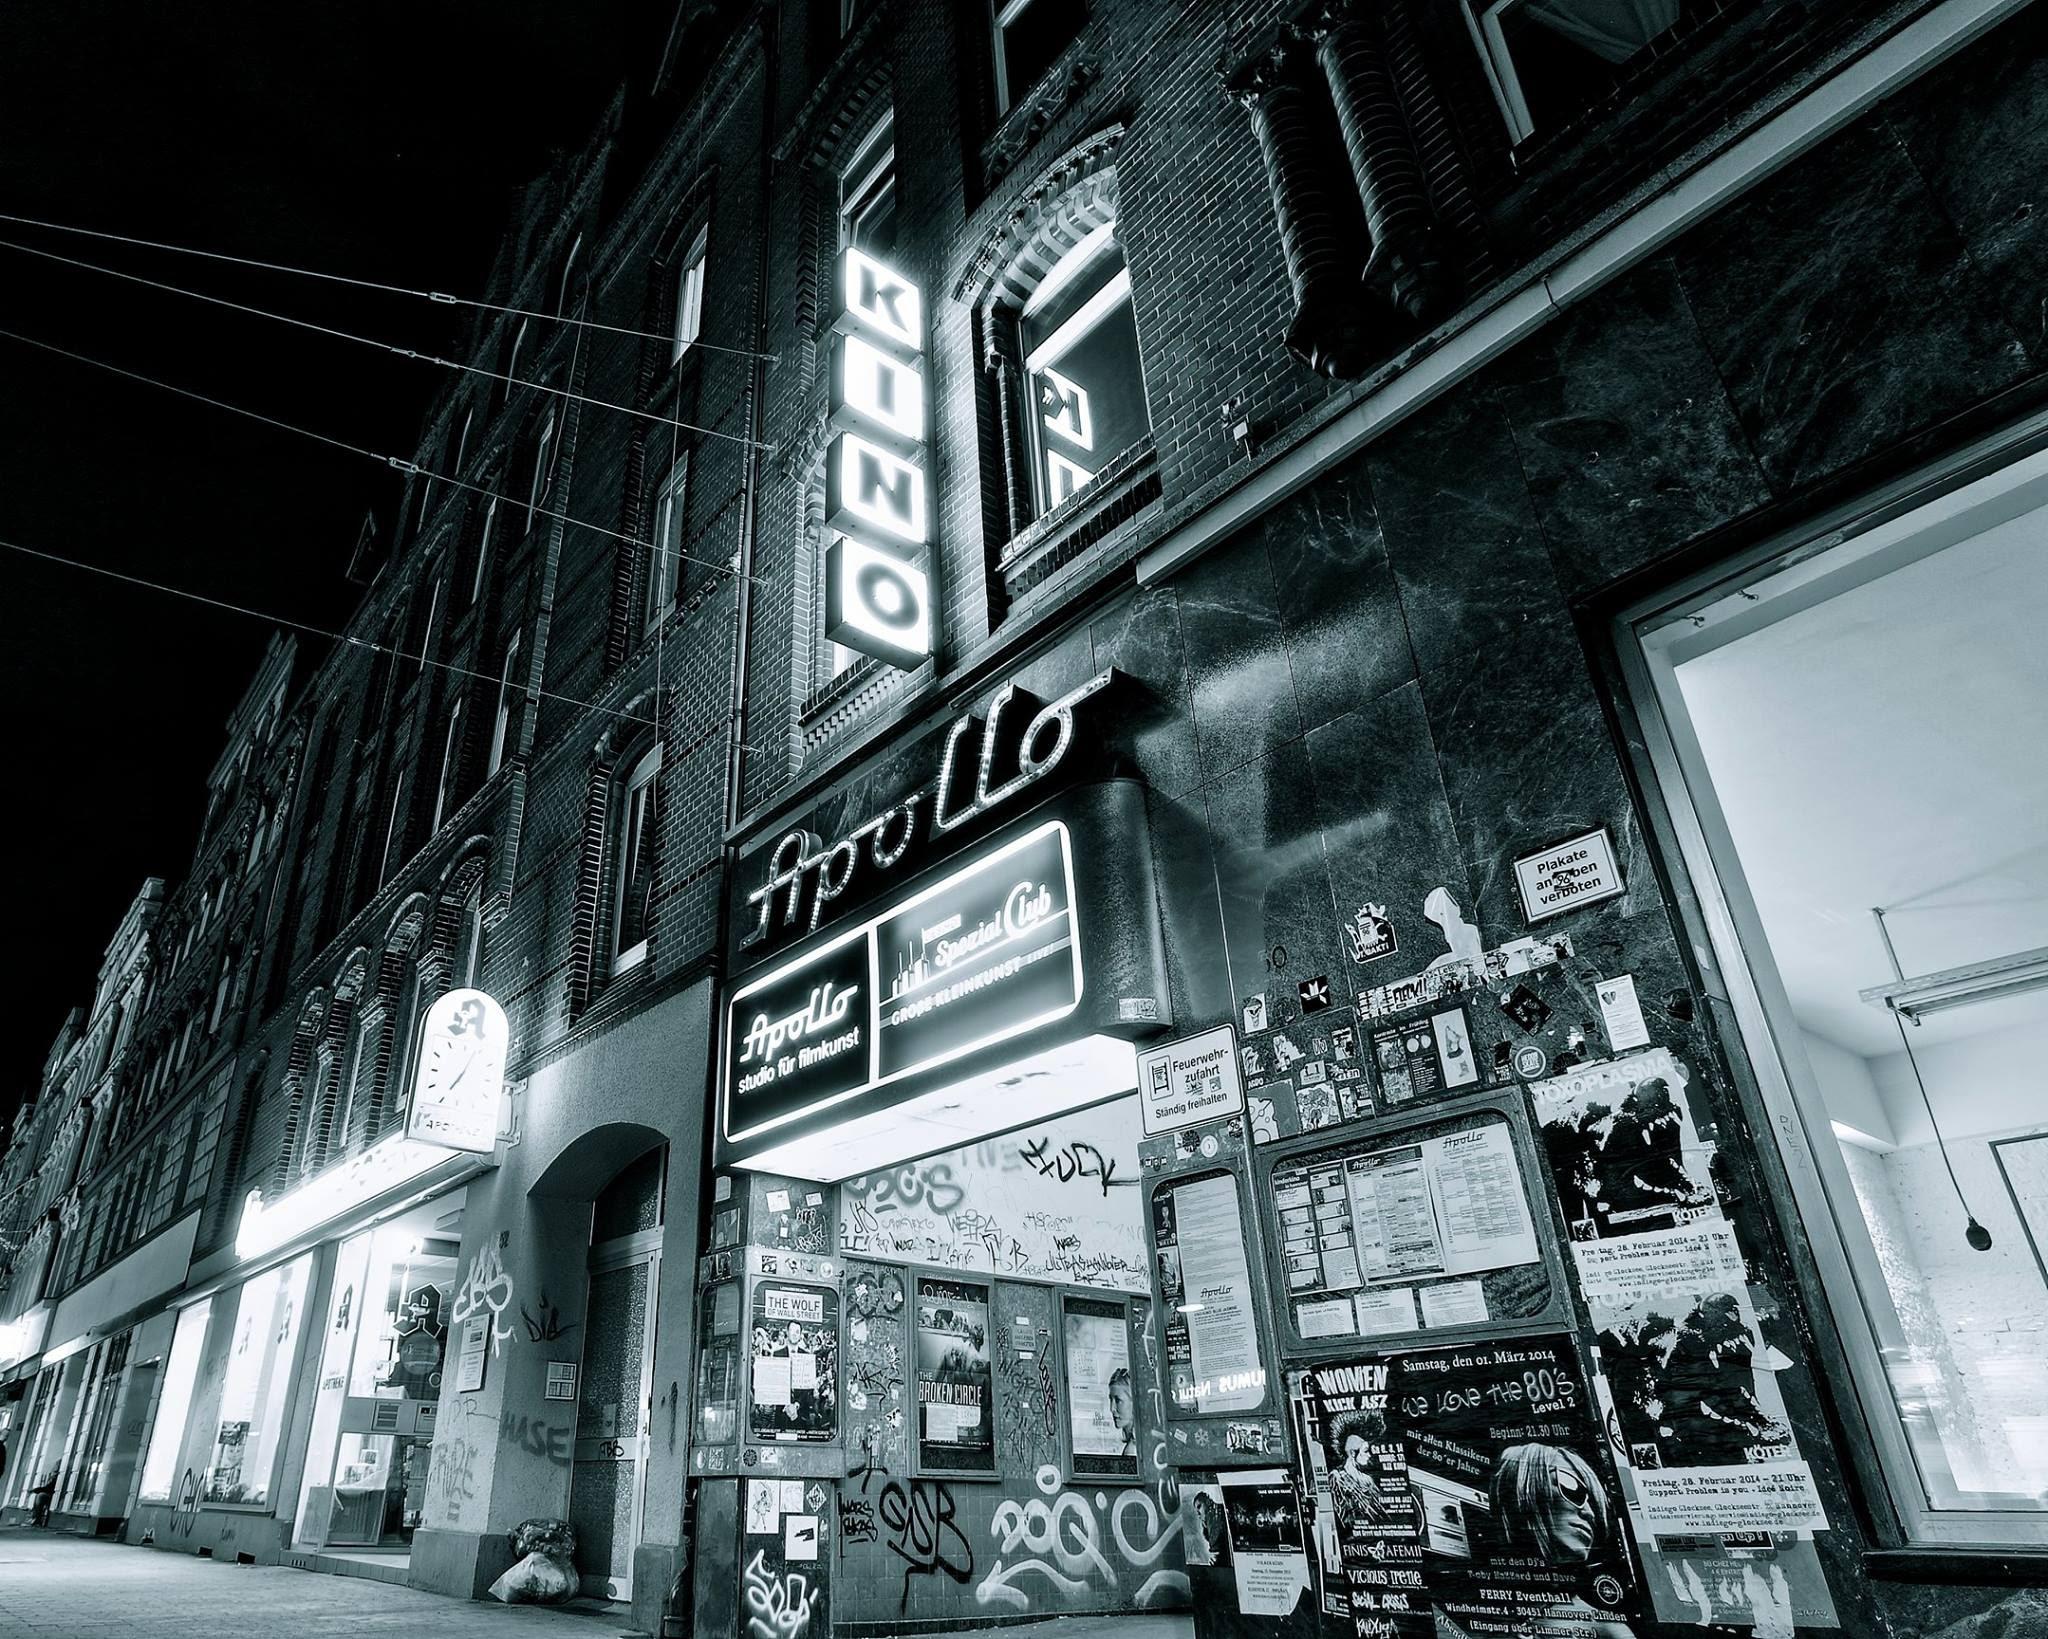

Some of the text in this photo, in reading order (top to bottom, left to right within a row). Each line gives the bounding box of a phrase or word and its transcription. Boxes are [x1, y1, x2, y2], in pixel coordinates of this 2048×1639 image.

[856, 260, 921, 632] KINO
[739, 668, 1113, 951] Apollo
[1537, 849, 1588, 875] Plakate
[1540, 876, 1601, 905] verboten
[934, 909, 1004, 968] Spezial
[1003, 881, 1052, 938] Club
[740, 982, 859, 1063] Apollo
[738, 1026, 860, 1095] studio für filmkunst
[1172, 1049, 1229, 1073] Feuerwehr-
[1184, 1064, 1221, 1083] zufahrt
[1155, 1091, 1228, 1119] Ständig freihalten
[1443, 1131, 1486, 1149] Apollo
[1352, 1158, 1381, 1170] Apollo
[1632, 1240, 1667, 1251] Februar
[1668, 1237, 1688, 1247] 2014
[1200, 1285, 1233, 1299] Apollo
[768, 1296, 821, 1312] THE WOLF
[767, 1308, 821, 1320] OF WALL STREET
[1402, 1350, 1556, 1373] Samstag, den 01. März 2014
[918, 1371, 934, 1381] THE
[1315, 1364, 1390, 1396] WOMEN
[1523, 1368, 1574, 1402] 80's
[918, 1380, 983, 1406] BROKEN CIRCLE
[1323, 1394, 1389, 1412] KICK ASZ
[1531, 1396, 1576, 1414] Level 2
[1489, 1423, 1571, 1440] Beginn: 21.30 Uhr
[1406, 1429, 1490, 1465] mit allen Klassikern
[1416, 1444, 1431, 1457] der
[1457, 1457, 1480, 1476] Jahre
[1642, 1473, 1807, 1490] Freitag, 28. Februar 2014 21 Uhr
[1648, 1488, 1684, 1498] Support
[1684, 1487, 1719, 1496] Problem
[1720, 1486, 1730, 1494] is
[1732, 1486, 1749, 1495] you
[1778, 1484, 1805, 1493] Noire
[1647, 1504, 1678, 1514] Indiego
[1342, 1544, 1369, 1558] FINIS
[1490, 1558, 1507, 1566] mit
[1508, 1557, 1525, 1566] den
[1533, 1571, 1551, 1582] und
[1552, 1573, 1577, 1583] Dave
[1479, 1589, 1574, 1603] FERRY Eventhall
[1516, 1606, 1541, 1616] 30451
[1543, 1608, 1592, 1620] Hannover
[1592, 1610, 1628, 1622] Linden
[1469, 1620, 1598, 1639] (Eingang über Limmer Str.)
